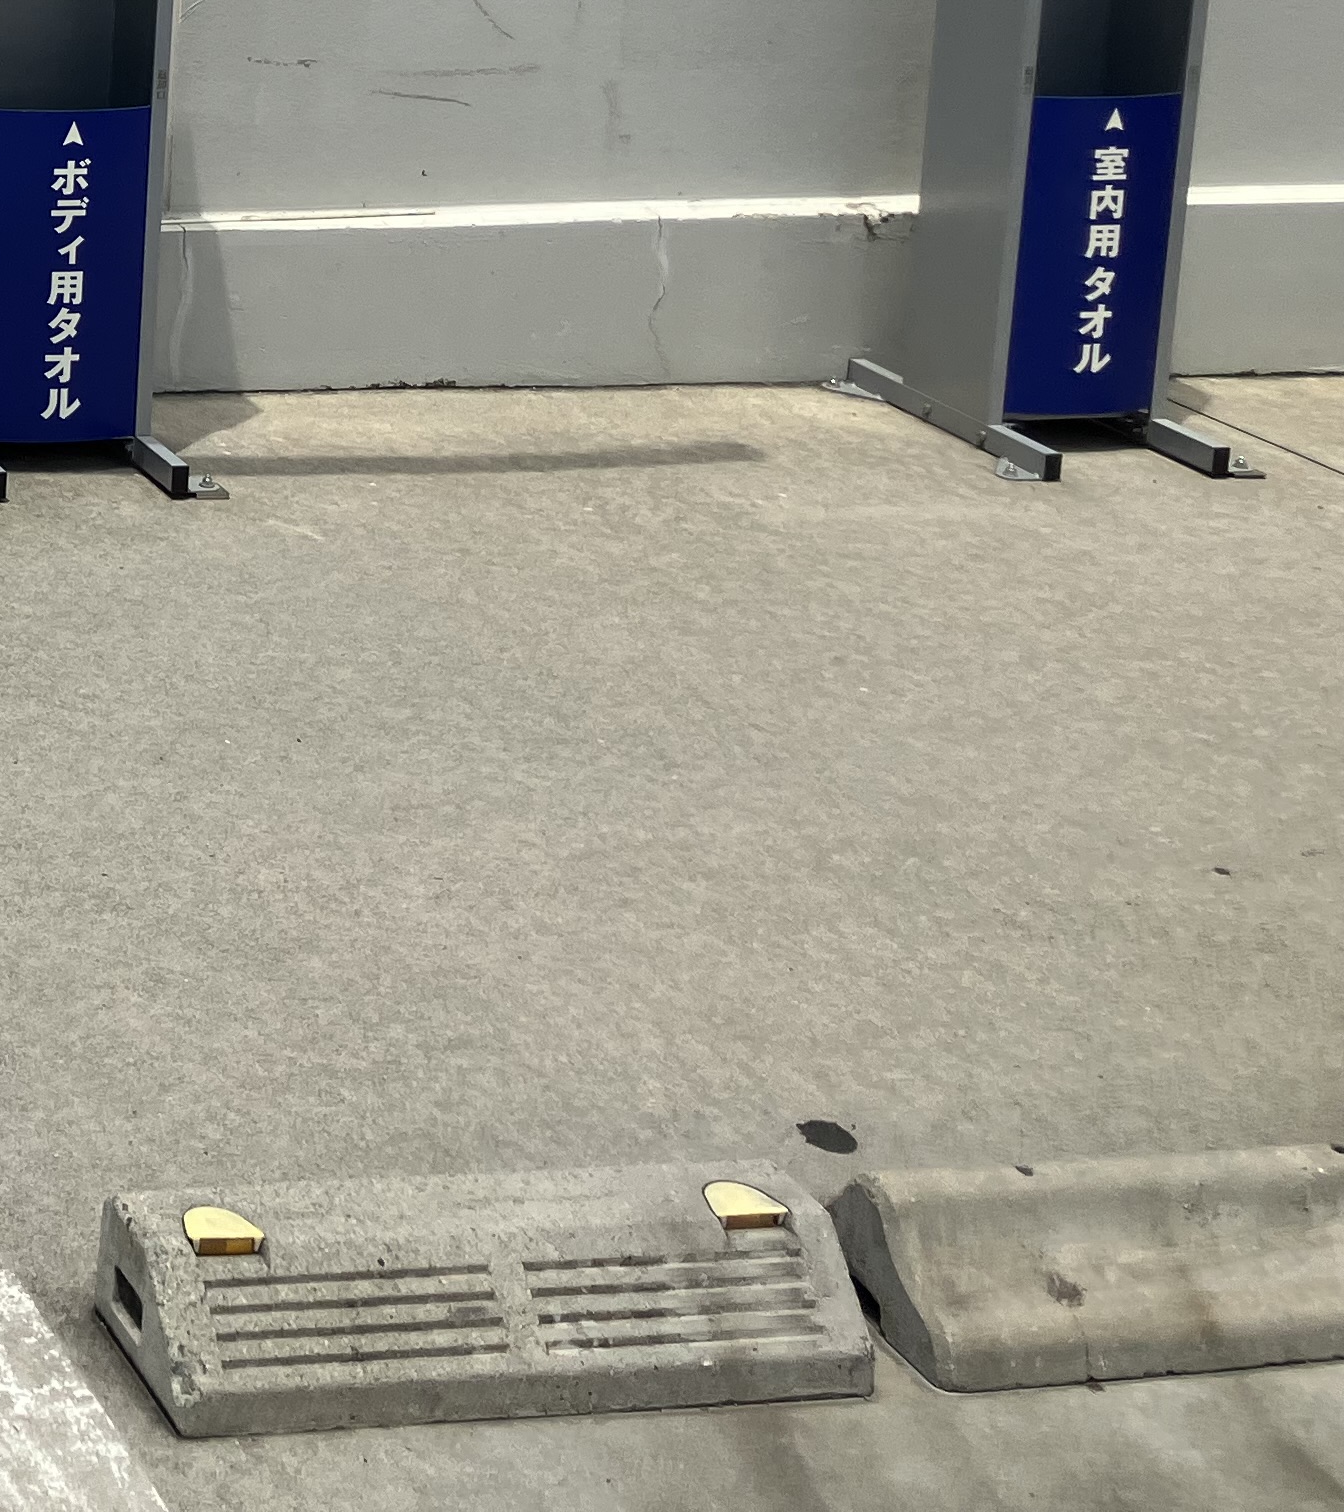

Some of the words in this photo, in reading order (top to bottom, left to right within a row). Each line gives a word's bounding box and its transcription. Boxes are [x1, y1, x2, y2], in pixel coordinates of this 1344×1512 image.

[40, 158, 92, 420] ボディ用タオル
[1073, 146, 1129, 374] 室内用タオル
